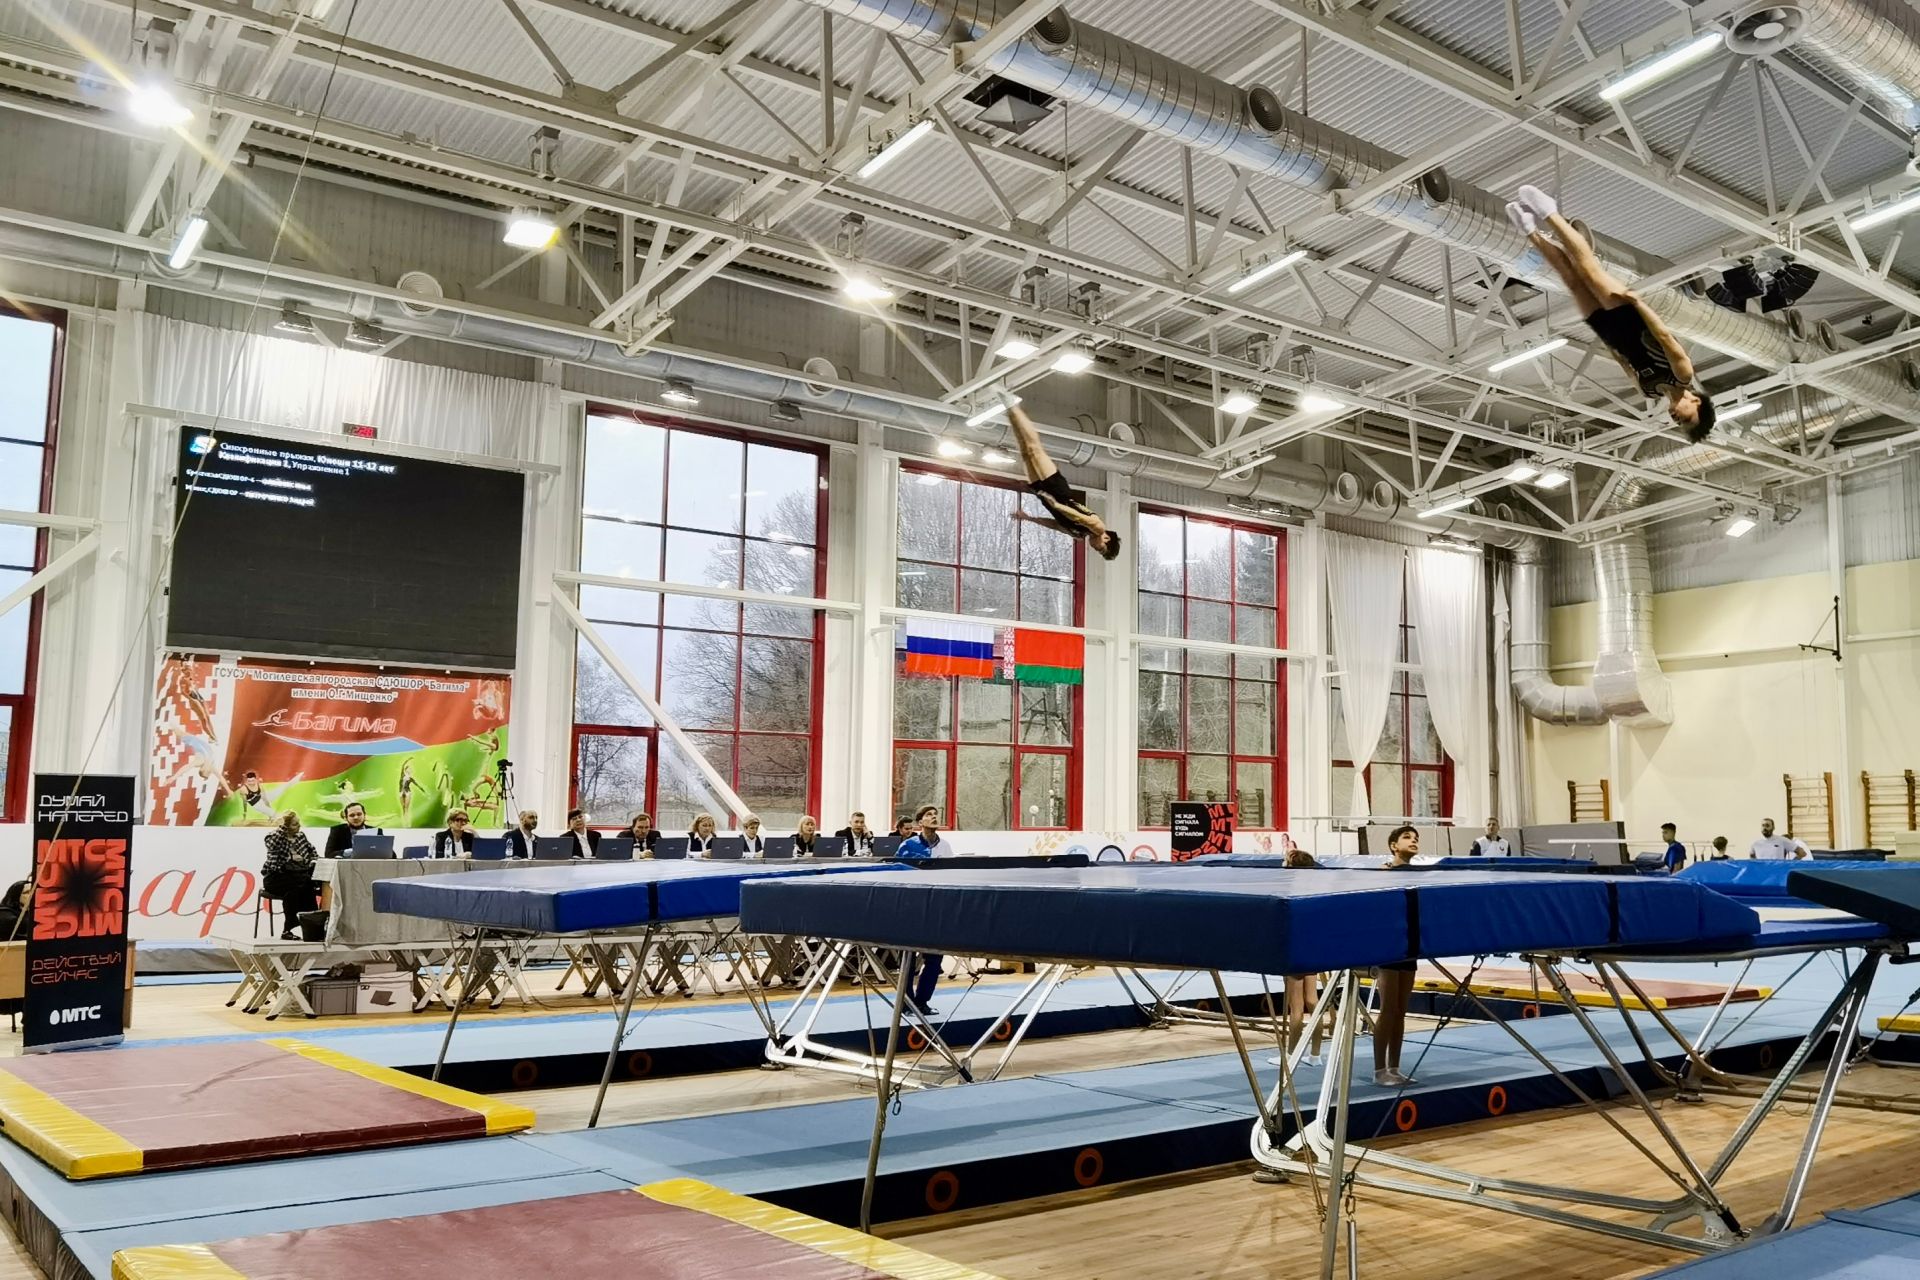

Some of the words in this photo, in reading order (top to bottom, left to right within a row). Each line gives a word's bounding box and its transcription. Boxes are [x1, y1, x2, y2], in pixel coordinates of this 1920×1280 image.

[213, 667, 247, 679] ГСУСУ
[323, 674, 375, 687] городская
[377, 676, 424, 689] СДЮШОР
[426, 680, 469, 692] "Багима"
[292, 688, 326, 698] имени
[290, 711, 397, 735] Багима
[38, 794, 106, 808] ДУМАЙ
[38, 810, 129, 823] НАПЕРЕД
[37, 839, 109, 864] МТС
[130, 866, 272, 938] ар
[31, 951, 122, 971] ДЕЙСТВУЙ
[31, 968, 99, 985] СЕЙЧАС
[61, 1005, 102, 1024] МТС
